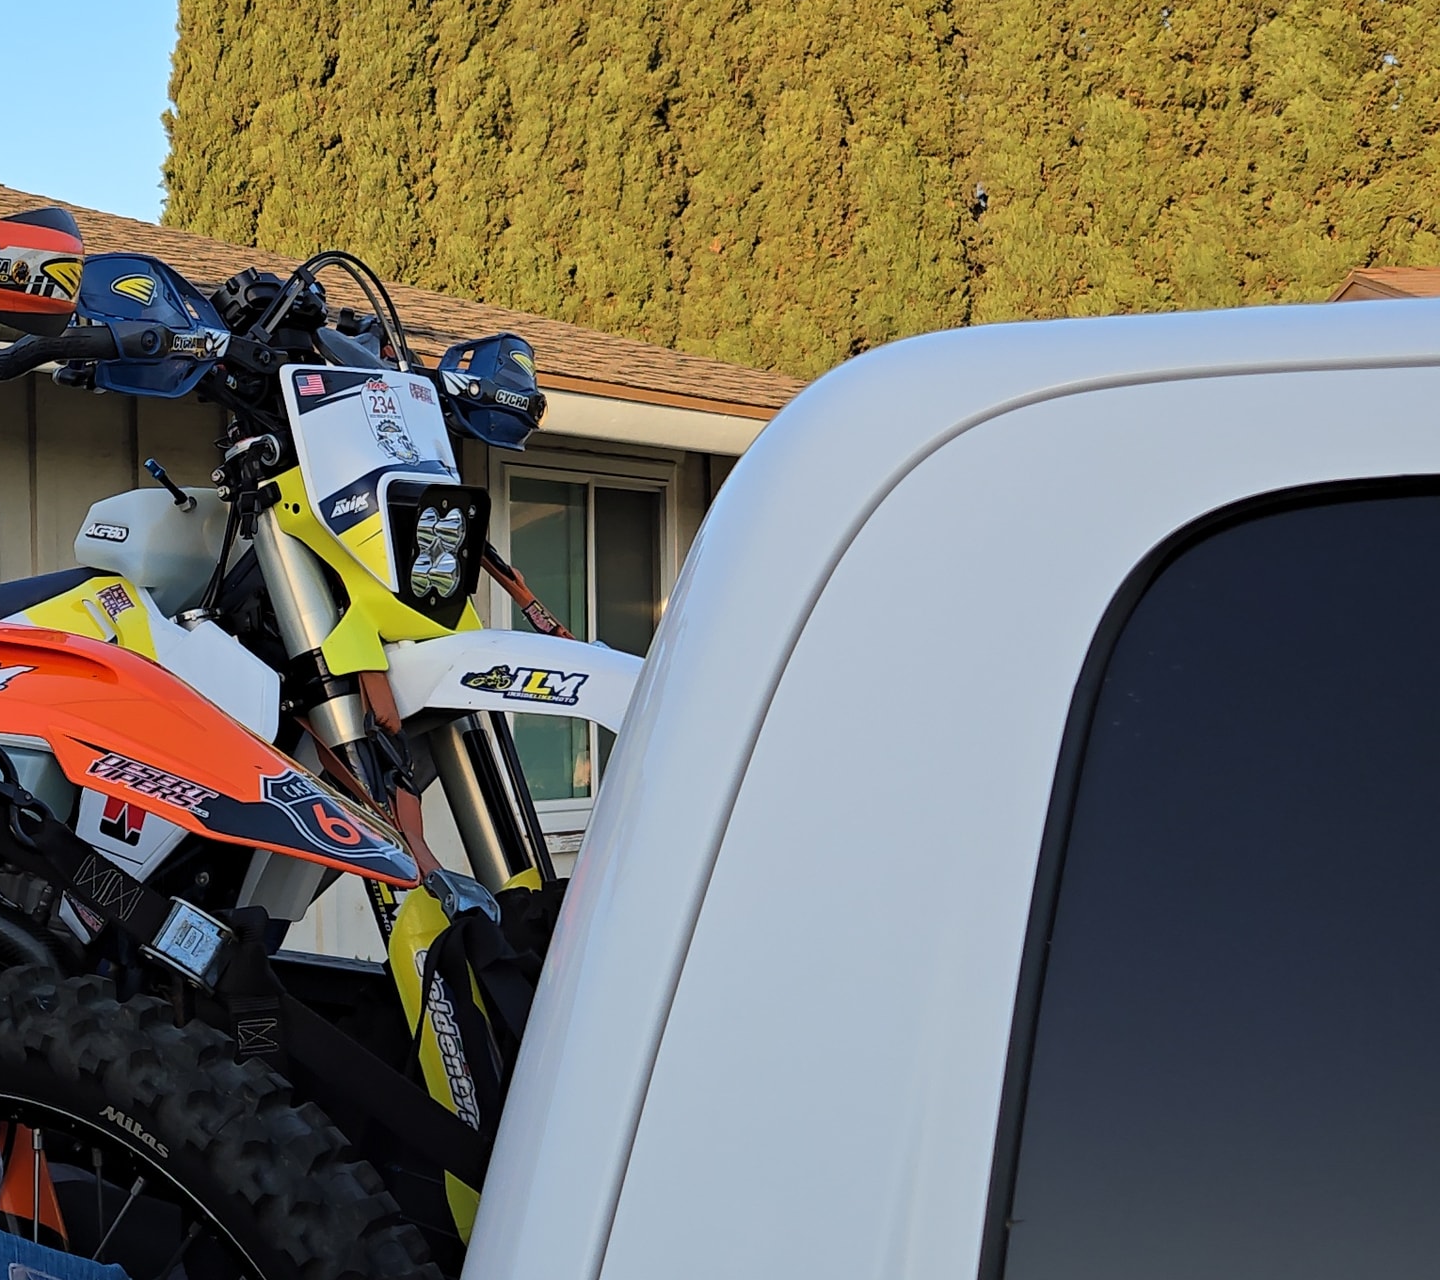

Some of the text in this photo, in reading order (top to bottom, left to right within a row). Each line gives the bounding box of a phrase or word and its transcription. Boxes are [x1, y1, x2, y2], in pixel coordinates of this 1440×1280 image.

[369, 395, 397, 414] 234
[496, 390, 529, 410] CYCRA
[508, 669, 586, 698] ILM
[87, 760, 204, 810] VIPERS
[99, 754, 219, 798] DESERT
[99, 1106, 170, 1158] Mitas
